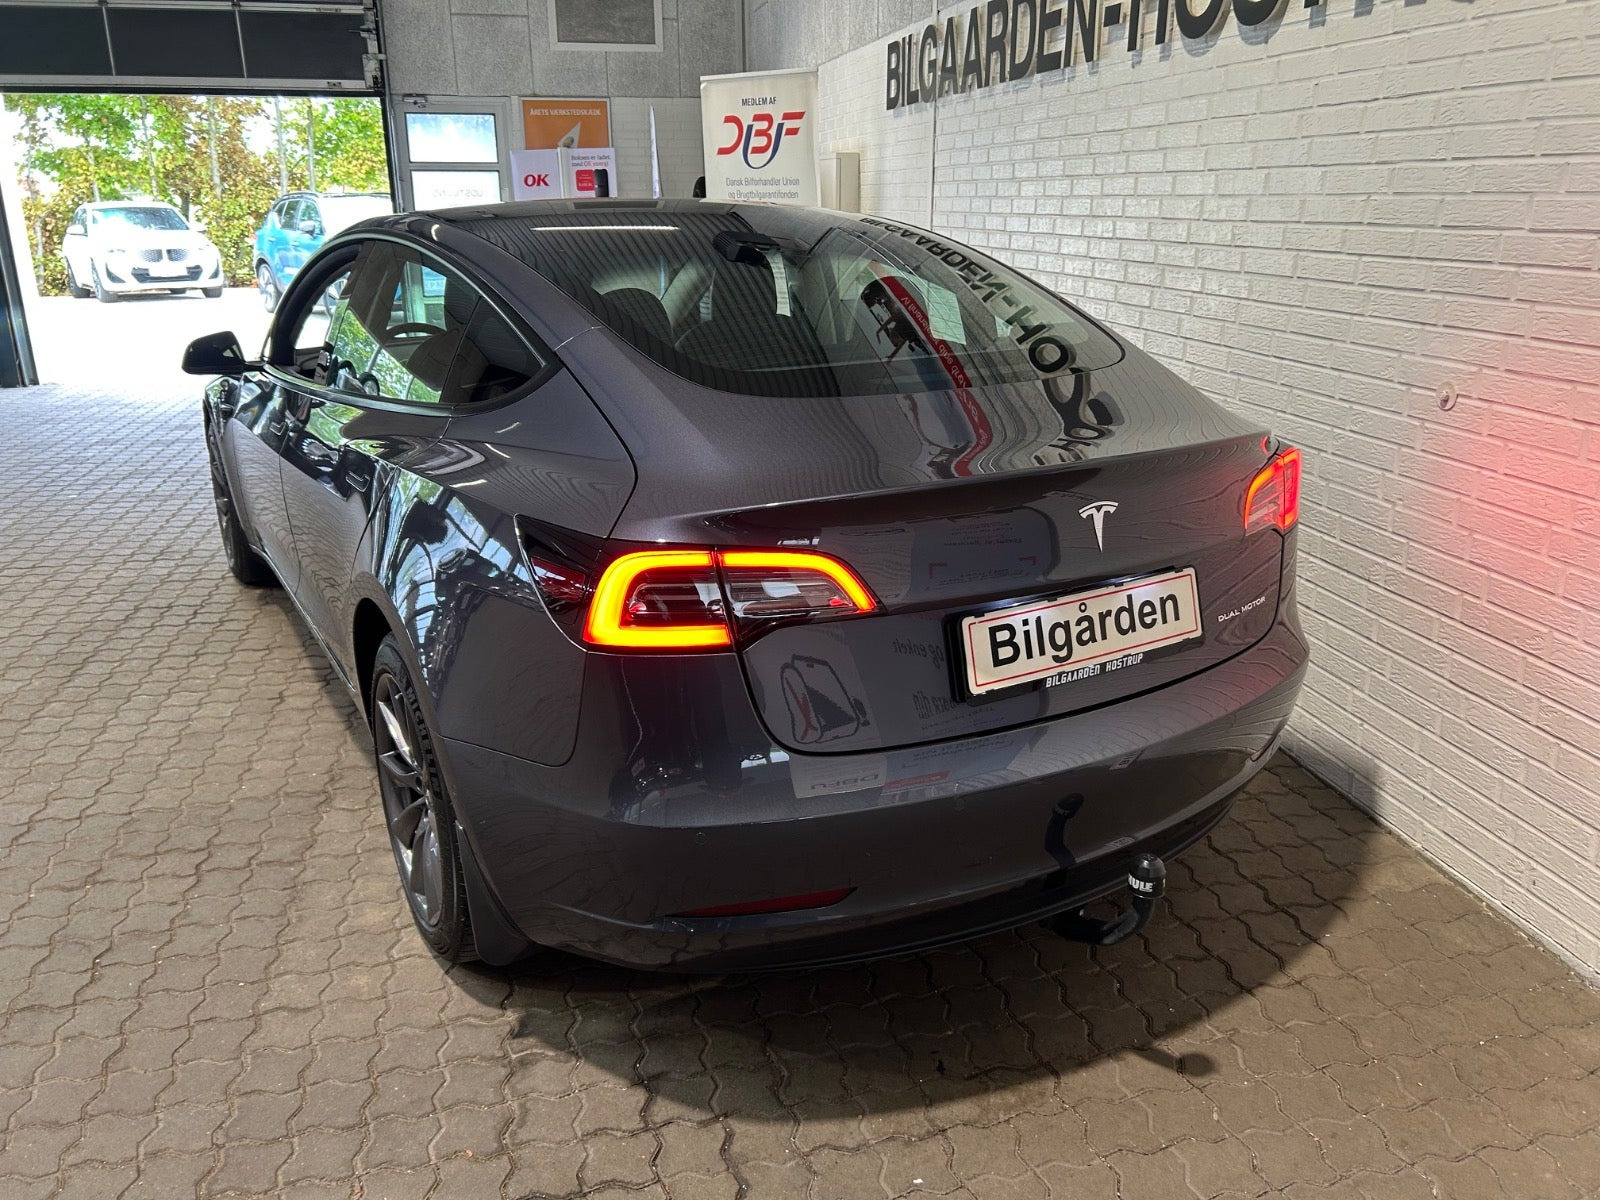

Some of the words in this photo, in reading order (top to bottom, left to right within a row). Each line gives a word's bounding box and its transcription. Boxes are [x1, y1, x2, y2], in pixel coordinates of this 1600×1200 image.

[741, 97, 768, 106] MEDLEM
[769, 96, 777, 105] AF
[523, 174, 550, 187] OK
[725, 177, 744, 187] Dansk
[744, 176, 782, 187] Bilforhandler
[782, 176, 800, 186] Union
[728, 191, 736, 200] og
[1217, 609, 1240, 622] DUAL
[1241, 596, 1266, 613] MOTOR
[987, 593, 1181, 668] Bilgården
[1045, 664, 1101, 688] BILGAARDEN
[1105, 652, 1144, 672] HOSTRUP
